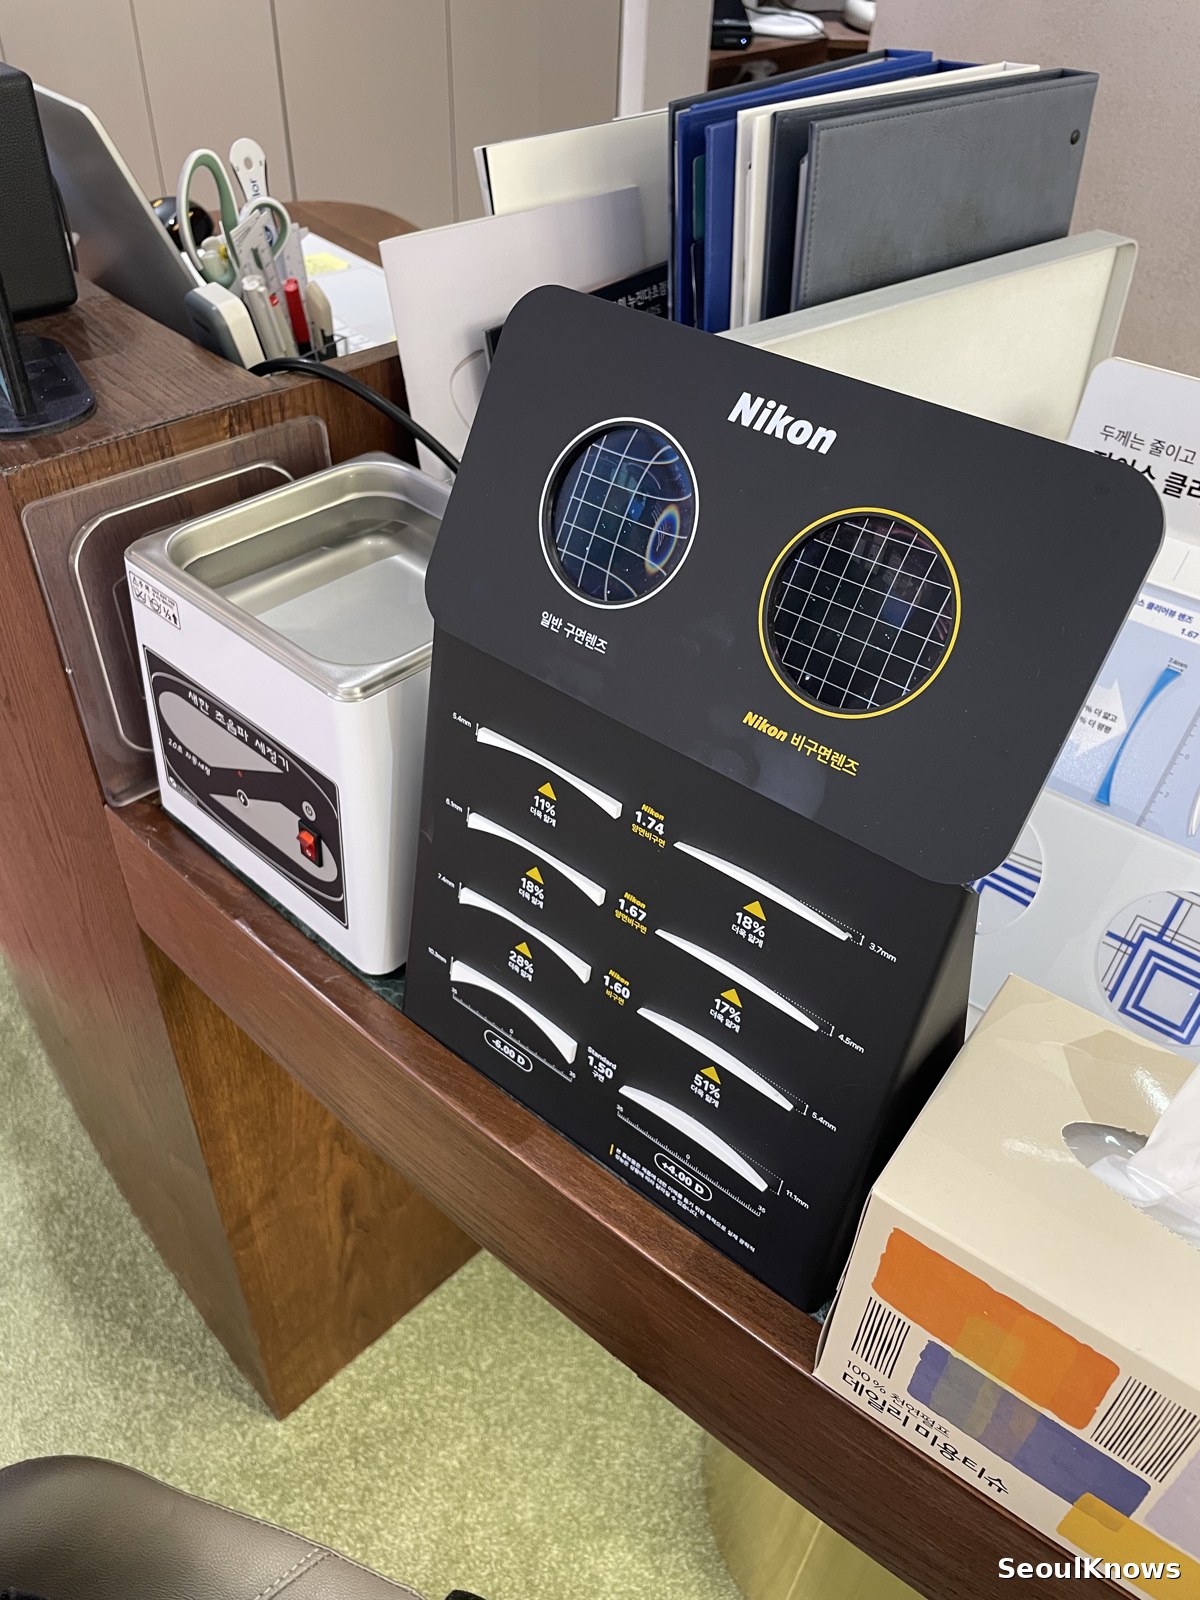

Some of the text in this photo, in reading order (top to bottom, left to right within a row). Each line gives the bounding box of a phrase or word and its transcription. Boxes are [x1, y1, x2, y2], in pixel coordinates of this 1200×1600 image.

[727, 391, 838, 455] Nikon
[1100, 425, 1196, 465] 두께는 줄이고
[1178, 612, 1194, 624] 렌즈
[540, 610, 608, 654] 일반 구면렌즈
[1181, 628, 1199, 639] 1.67
[452, 711, 472, 728] 5.4mm
[742, 711, 860, 777] Nikon 비구면렌즈
[529, 806, 543, 820] 더욱
[533, 795, 556, 817] 11%
[641, 803, 665, 821] Nikon
[635, 811, 665, 836] 1.74
[520, 877, 545, 900] 18%
[623, 891, 646, 909] Nikon
[618, 898, 647, 922] 1.67
[731, 923, 764, 949] 더욱 얇게
[735, 911, 766, 938] 18%
[508, 950, 534, 974] 28%
[868, 942, 897, 963] 3.7mm
[603, 975, 631, 999] 1.60
[709, 1008, 724, 1023] 더욱
[714, 998, 741, 1024] 17%
[492, 1039, 526, 1066] -6.00 D
[837, 1033, 865, 1054] 4.5mm
[587, 1046, 617, 1070] Standard
[587, 1055, 613, 1079] 1.50
[690, 1083, 704, 1098] 더욱
[693, 1073, 721, 1099] 51%
[811, 1111, 837, 1132] 5.4mm
[661, 1162, 705, 1195] +4.00 D
[785, 1189, 810, 1210] 11.1mm
[890, 1392, 950, 1439] 천연펄프
[842, 1371, 1009, 1494] 데일리 미용티슈
